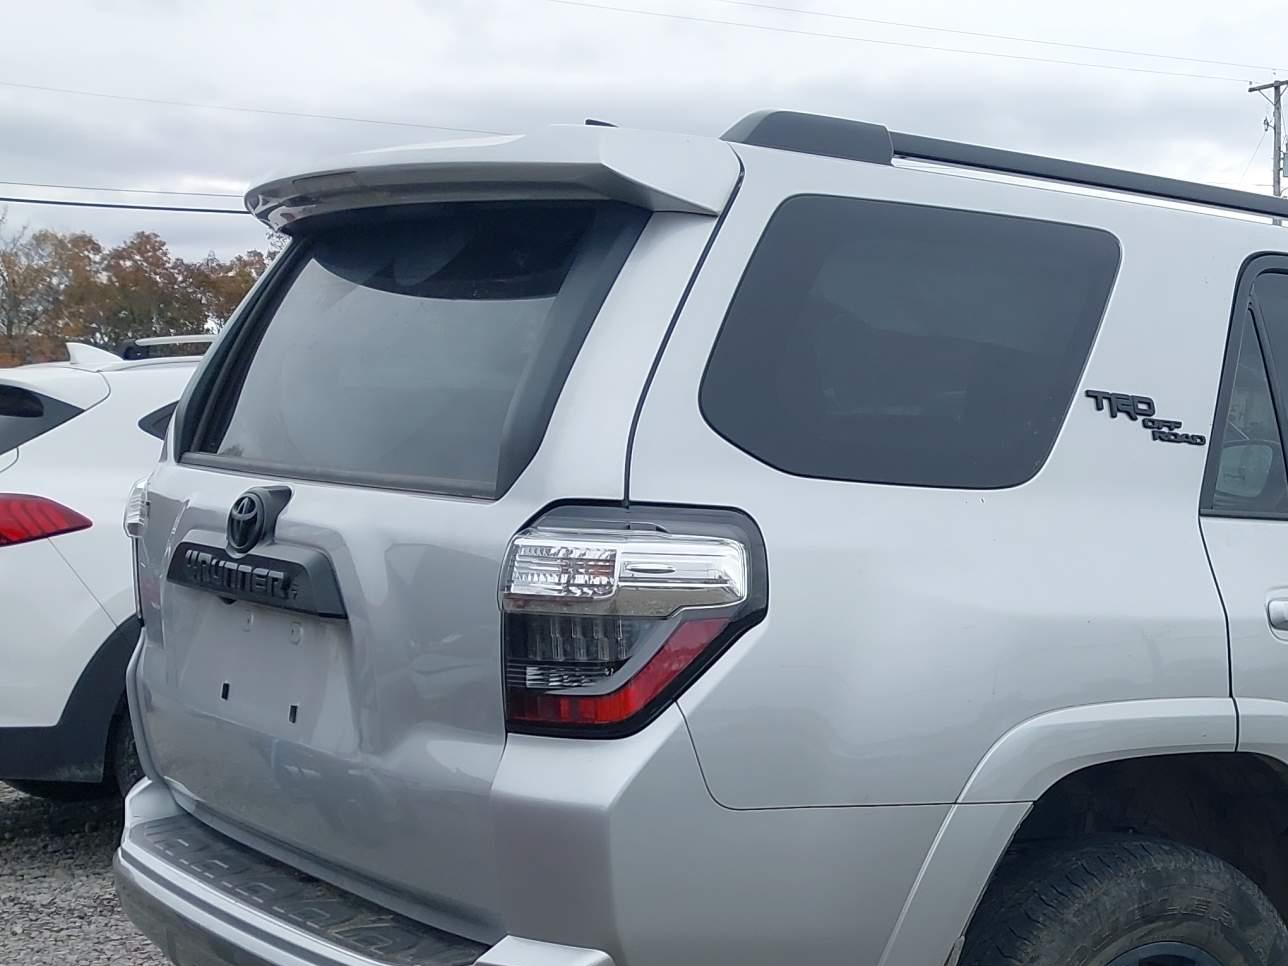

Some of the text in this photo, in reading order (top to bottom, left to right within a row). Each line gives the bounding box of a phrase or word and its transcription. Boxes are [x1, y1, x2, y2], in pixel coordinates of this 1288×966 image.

[1085, 389, 1156, 421] TRD
[1141, 417, 1183, 432] OFF
[1151, 430, 1207, 446] ROAD
